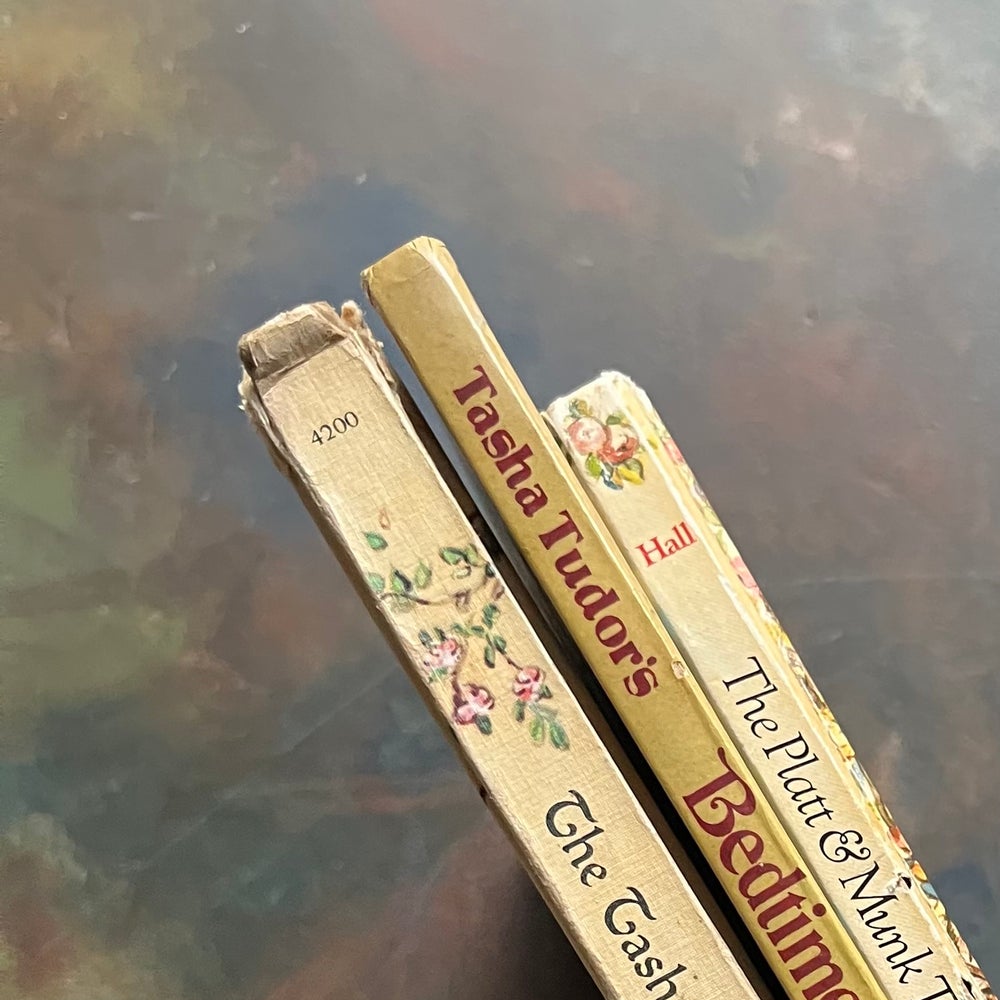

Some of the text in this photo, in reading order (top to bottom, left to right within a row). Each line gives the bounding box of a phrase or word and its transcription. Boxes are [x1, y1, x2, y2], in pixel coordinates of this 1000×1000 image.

[310, 410, 360, 447] 4200
[452, 364, 551, 518] Tasha
[538, 510, 660, 698] Tudor's
[635, 522, 697, 567] Hall
[721, 656, 779, 739] The
[762, 731, 833, 828] Platt
[545, 789, 607, 888] The
[819, 829, 871, 863] &
[838, 862, 934, 985] Munk
